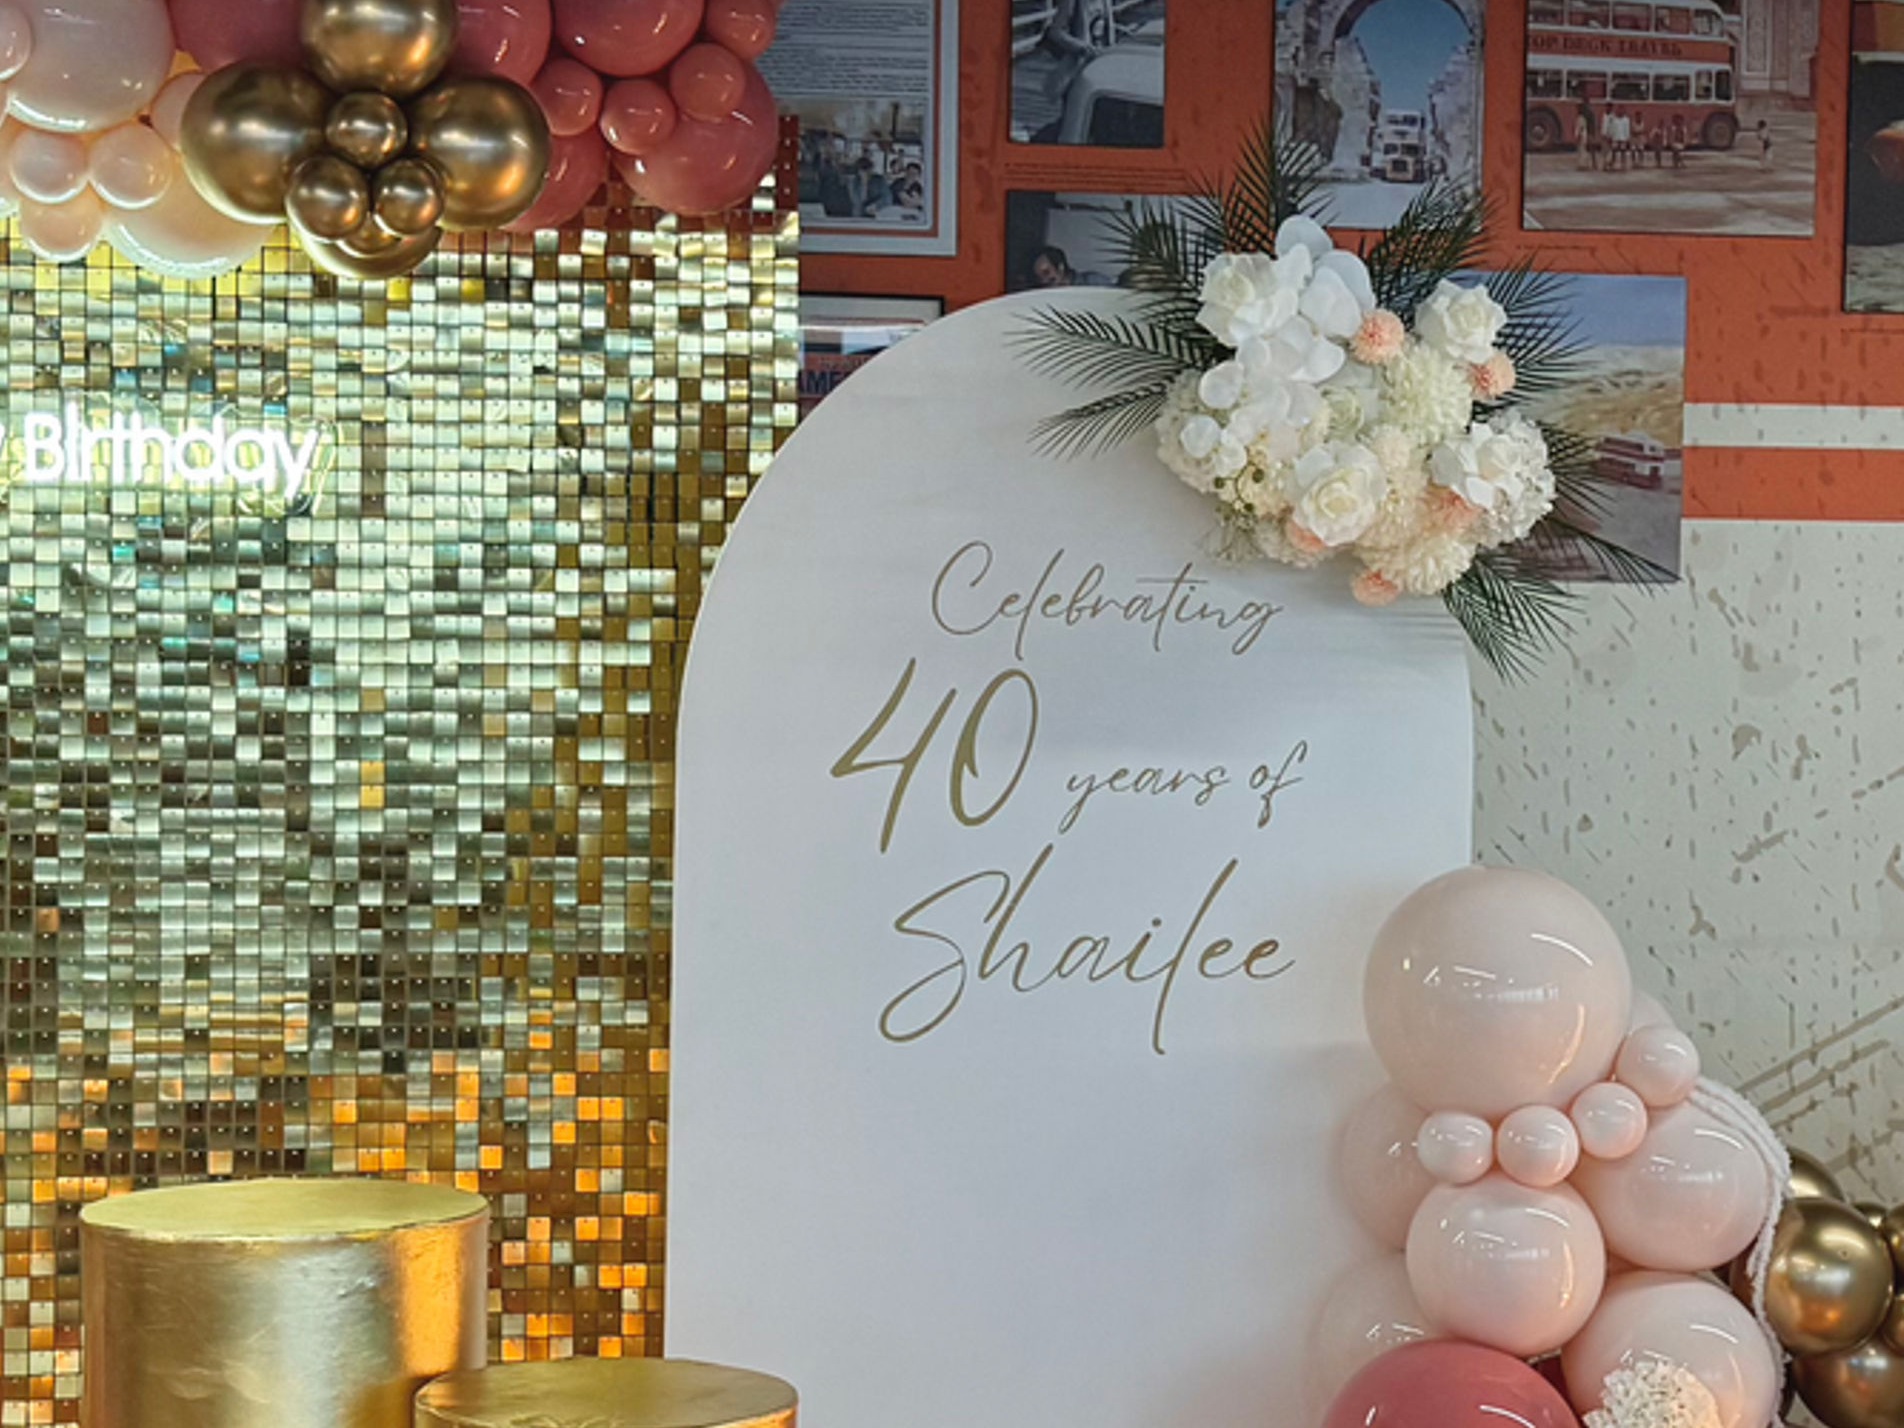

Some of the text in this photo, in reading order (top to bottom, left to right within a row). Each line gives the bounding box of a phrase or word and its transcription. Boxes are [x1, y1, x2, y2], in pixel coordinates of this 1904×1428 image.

[21, 401, 322, 502] Birthday
[931, 539, 1285, 662] Celebrating
[829, 656, 1309, 855] 40 years of
[878, 842, 1296, 1057] Shailee
